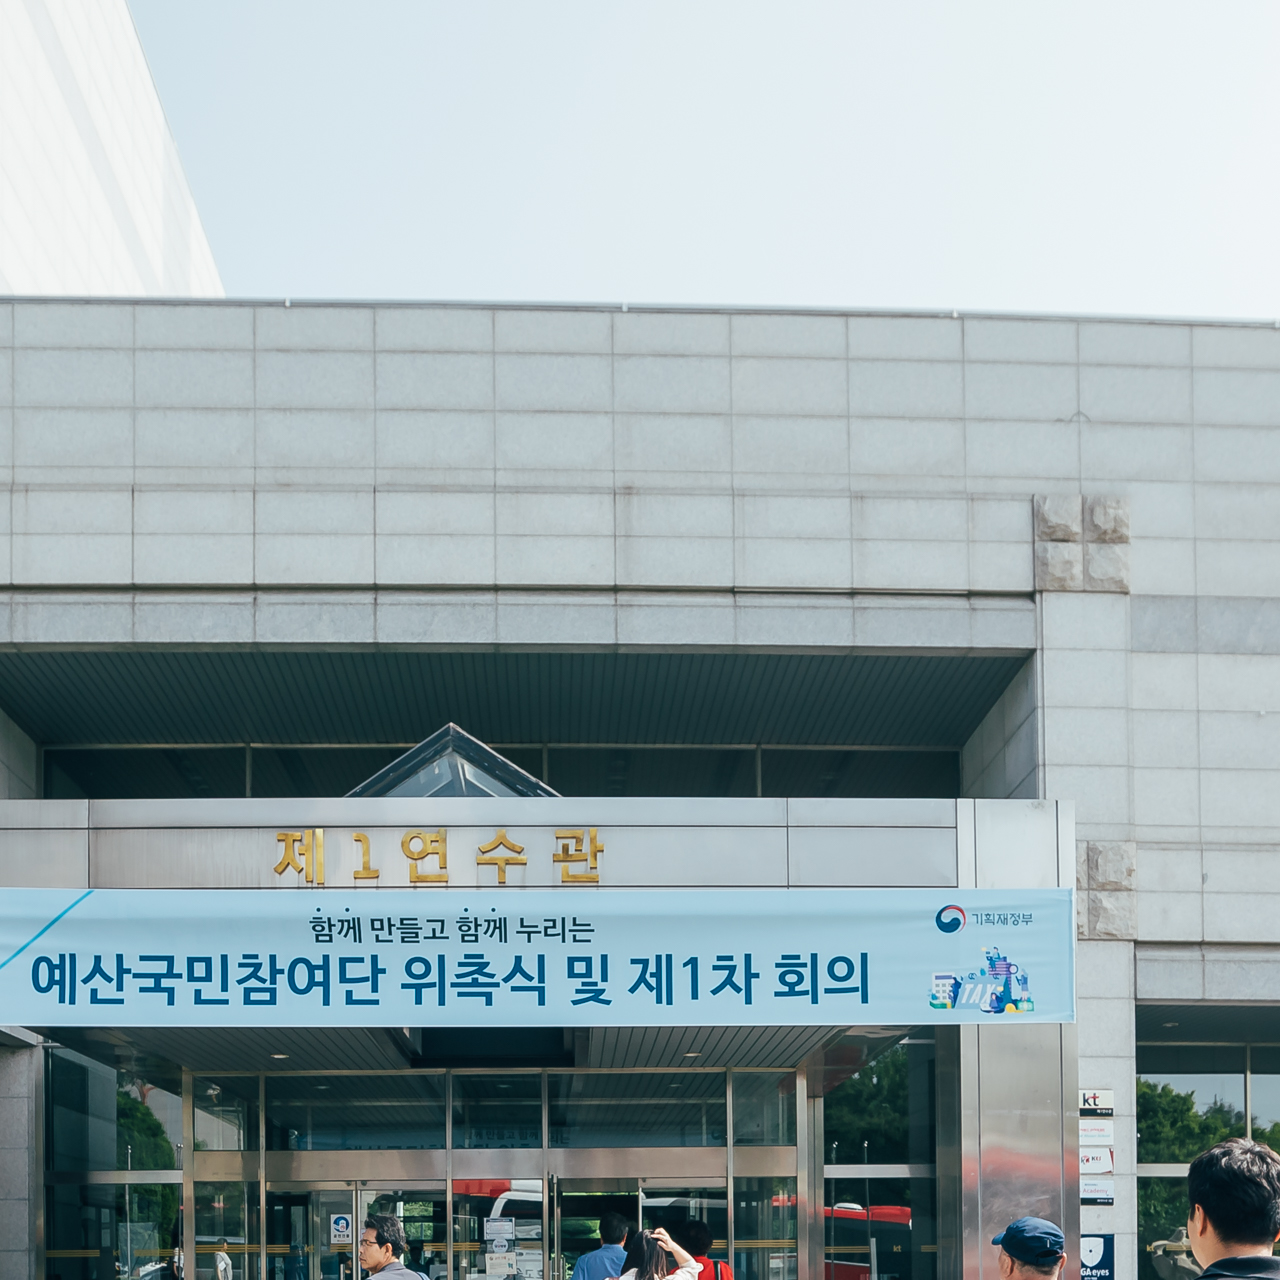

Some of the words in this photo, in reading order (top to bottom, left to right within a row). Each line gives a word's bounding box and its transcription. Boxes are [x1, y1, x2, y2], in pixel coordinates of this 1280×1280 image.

[273, 828, 605, 884] 제1연수관
[971, 912, 1033, 926] 기획재정부
[309, 916, 362, 944] 함께
[370, 916, 450, 944] 만들고
[455, 916, 508, 944] 함께
[514, 916, 595, 944] 누리는
[31, 952, 387, 1006] 예산국민참여단
[400, 953, 547, 1006] 위촉식
[565, 953, 613, 1006] 및
[627, 953, 760, 1006] 제1차
[773, 952, 870, 1005] 회의
[961, 983, 997, 1004] TAX
[1082, 1092, 1100, 1107] kt
[1082, 1187, 1109, 1195] Academy
[1092, 1269, 1109, 1277] eyes
